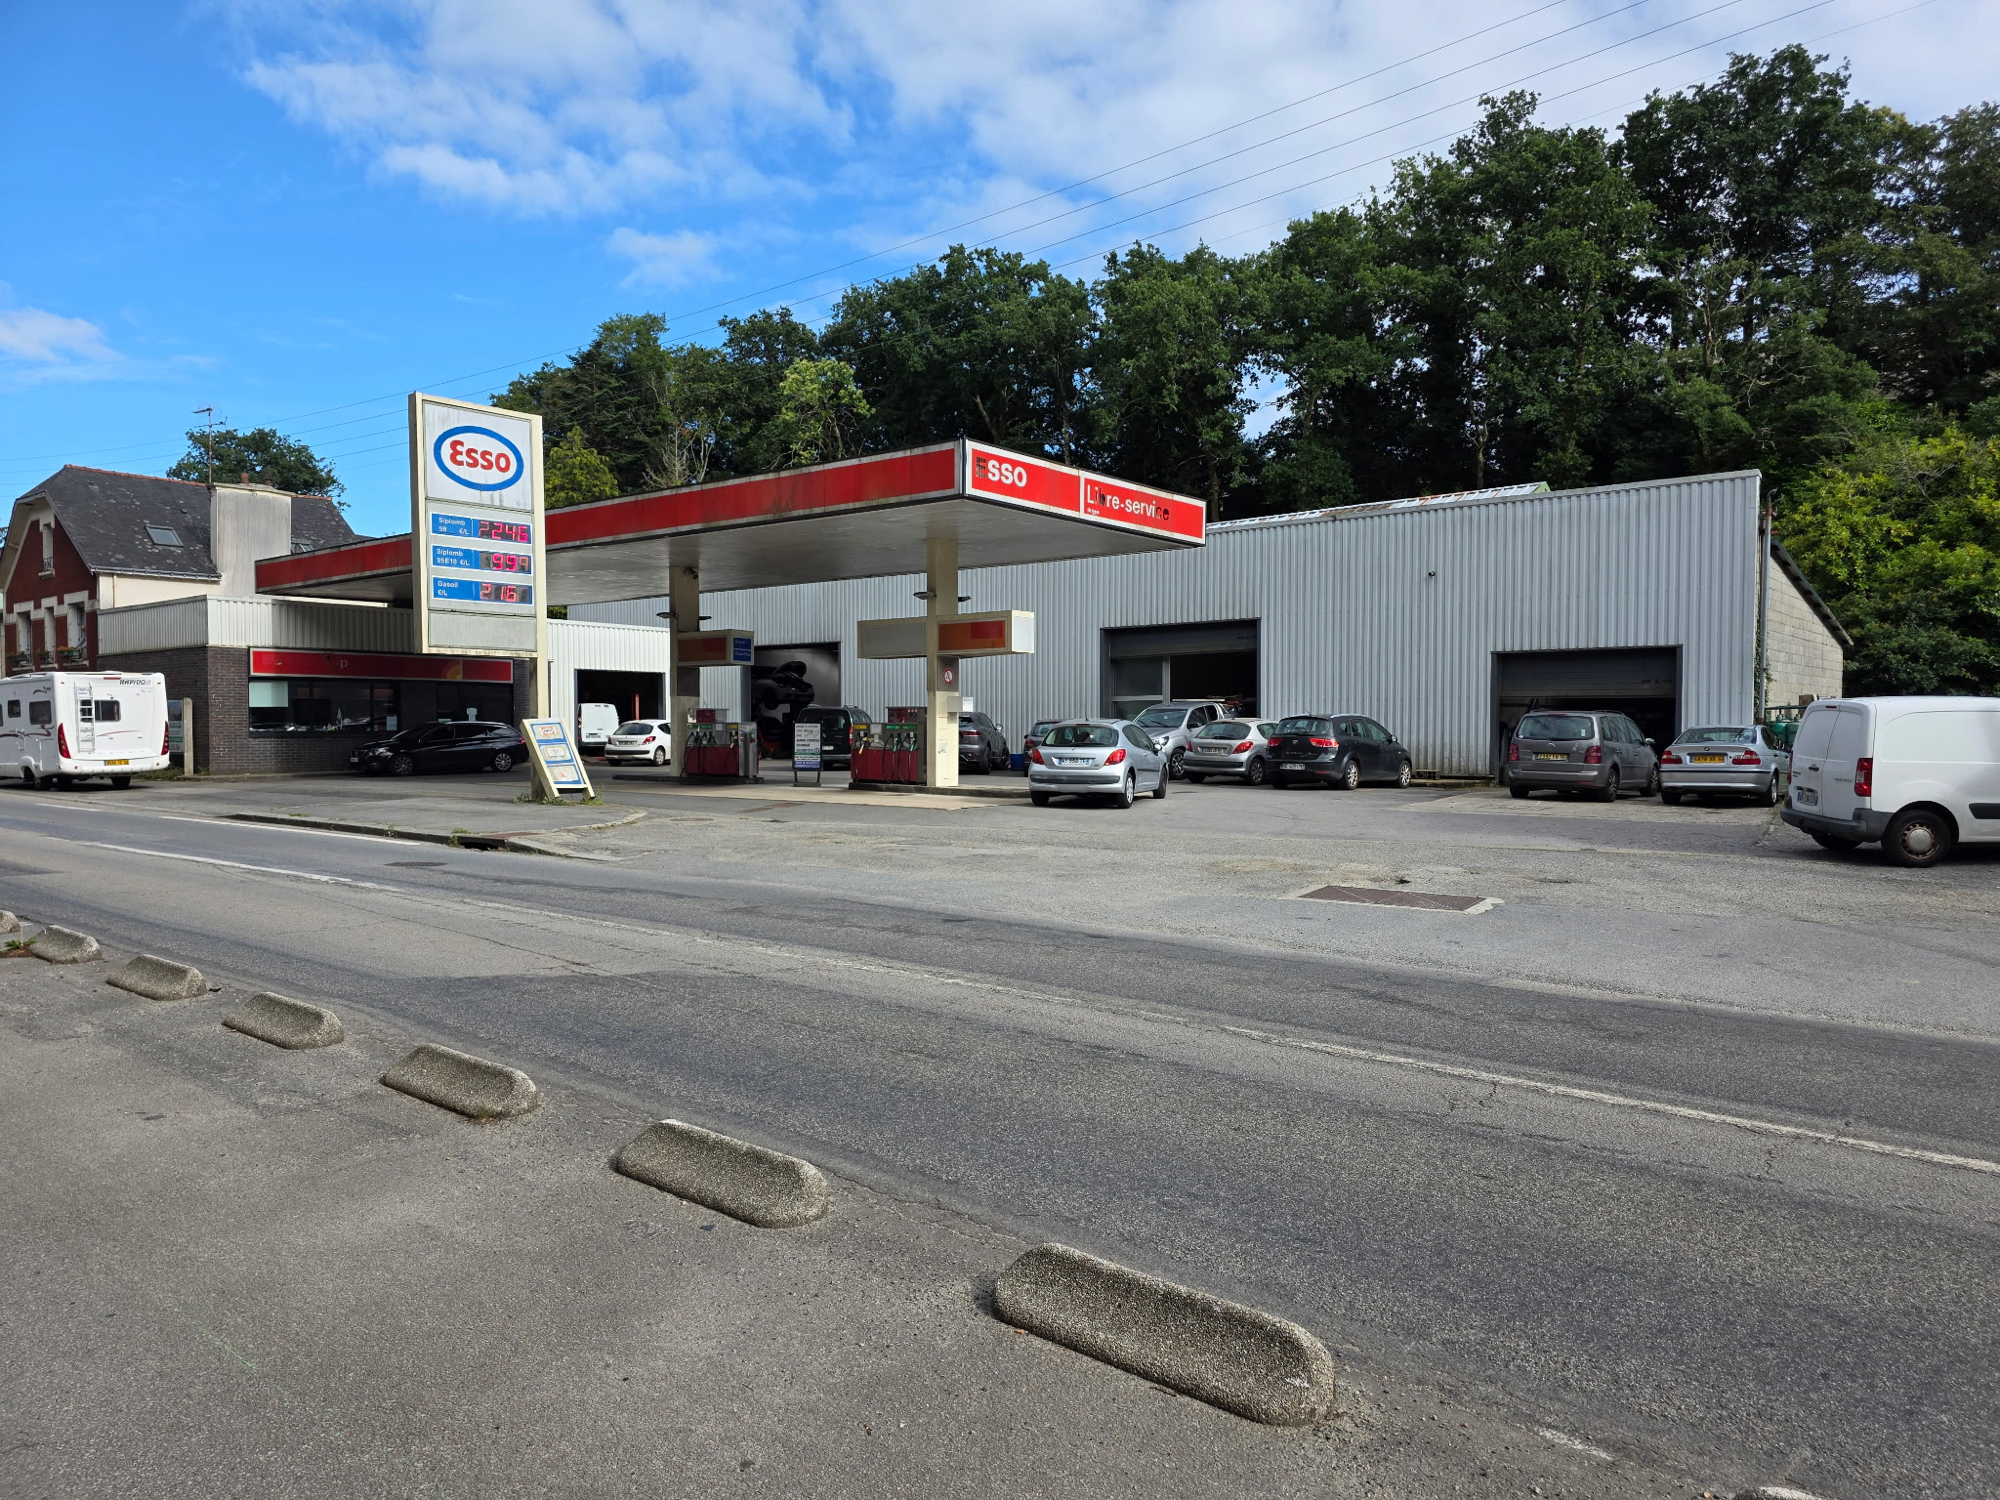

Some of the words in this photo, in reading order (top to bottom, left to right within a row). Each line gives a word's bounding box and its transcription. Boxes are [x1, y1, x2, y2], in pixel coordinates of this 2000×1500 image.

[438, 517, 466, 526] S/plomb
[436, 548, 464, 557] S/plomb
[437, 580, 459, 588] Gasoil
